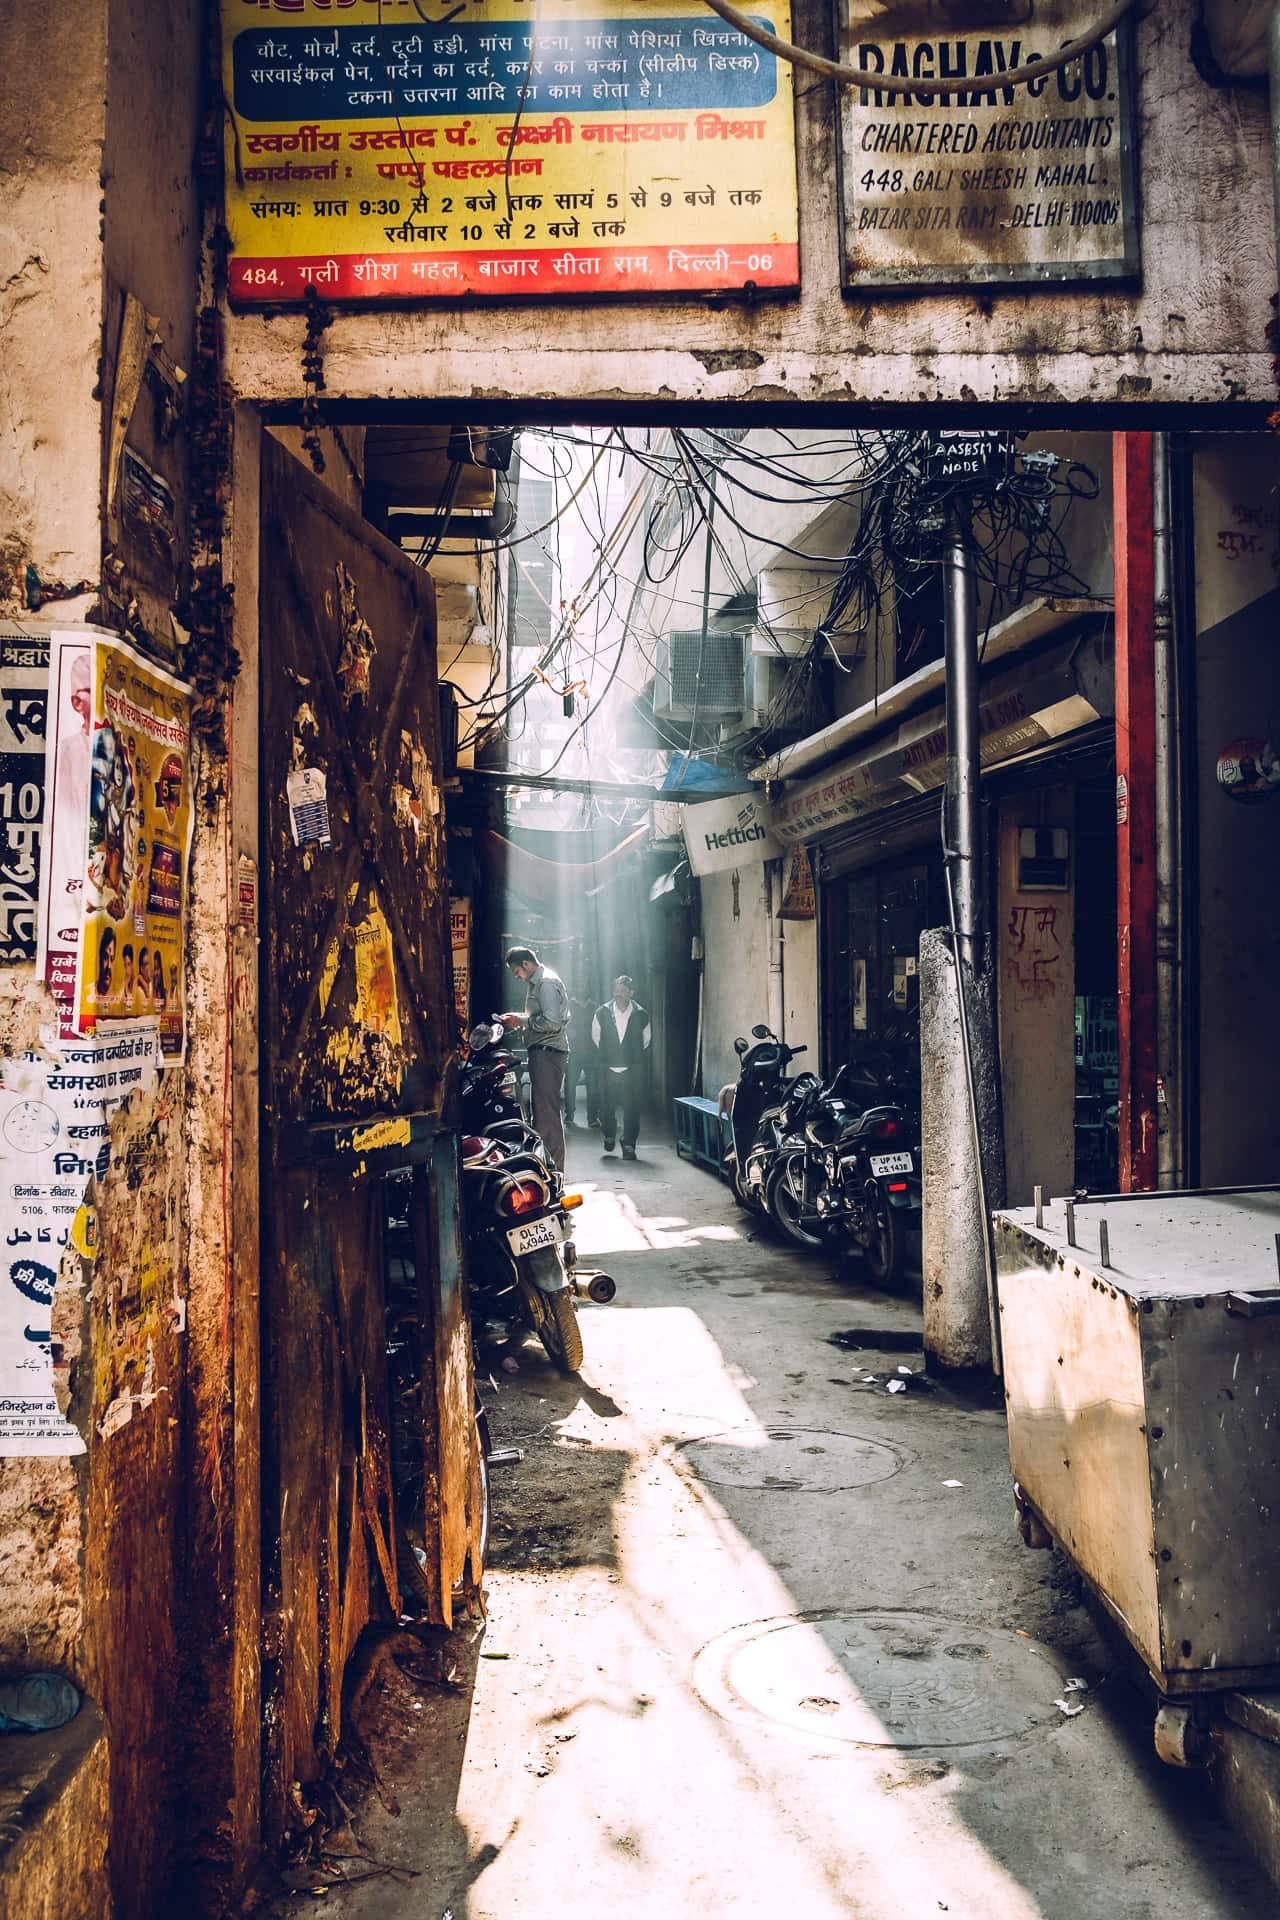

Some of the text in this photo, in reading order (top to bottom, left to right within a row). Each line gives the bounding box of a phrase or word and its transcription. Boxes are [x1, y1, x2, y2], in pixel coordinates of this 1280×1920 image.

[392, 35, 424, 60] टूटी
[479, 34, 513, 52] मांस
[629, 29, 682, 50] पेशियां
[433, 62, 455, 78] का
[553, 59, 575, 75] का
[708, 51, 760, 74] डिस्क)
[858, 40, 1022, 108] RAGHAV
[347, 89, 393, 106] टकना
[404, 86, 458, 103] उतरना
[466, 81, 507, 101] आदि
[548, 84, 582, 100] काम
[592, 78, 629, 98] होता
[246, 125, 341, 154] स्वर्गीय
[349, 127, 436, 152] उस्ताद
[496, 116, 575, 148] लक्ष्मी
[581, 121, 688, 145] नारायण
[695, 113, 768, 142] मिश्रा
[861, 115, 1114, 154] CHARTERED ACCOUNTANTS
[432, 158, 545, 180] पहलवान
[912, 169, 953, 193] GALI
[960, 166, 1027, 192] SHEESH
[313, 199, 348, 216] प्रात
[359, 199, 400, 215] 9:30
[411, 193, 428, 213] से
[441, 198, 453, 213] 2
[465, 189, 497, 212] बजे
[509, 193, 544, 212] तक
[554, 188, 595, 210] सायं
[606, 193, 618, 209] 5
[629, 186, 648, 208] से
[660, 192, 672, 207] 9
[684, 184, 716, 207] बजे
[727, 189, 763, 206] तक
[460, 225, 482, 241] 10
[493, 217, 513, 240] से
[524, 224, 536, 239] 2
[547, 216, 581, 238] बजे
[592, 220, 627, 237] तक
[858, 206, 910, 231] BAZAR
[914, 206, 953, 231] SITA
[241, 267, 286, 287] 484,
[297, 260, 341, 283] गली
[353, 258, 399, 282] शीश
[411, 260, 465, 282] महल,
[477, 257, 540, 279] बाजार
[552, 252, 600, 276] सीता
[942, 460, 979, 475] NODE
[704, 821, 767, 852] Hettich
[47, 1073, 107, 1091] समस्या
[879, 1156, 891, 1165] UP
[14, 1185, 41, 1198] दिनांक
[519, 1223, 547, 1240] DL7S
[519, 1231, 556, 1252] AX9445
